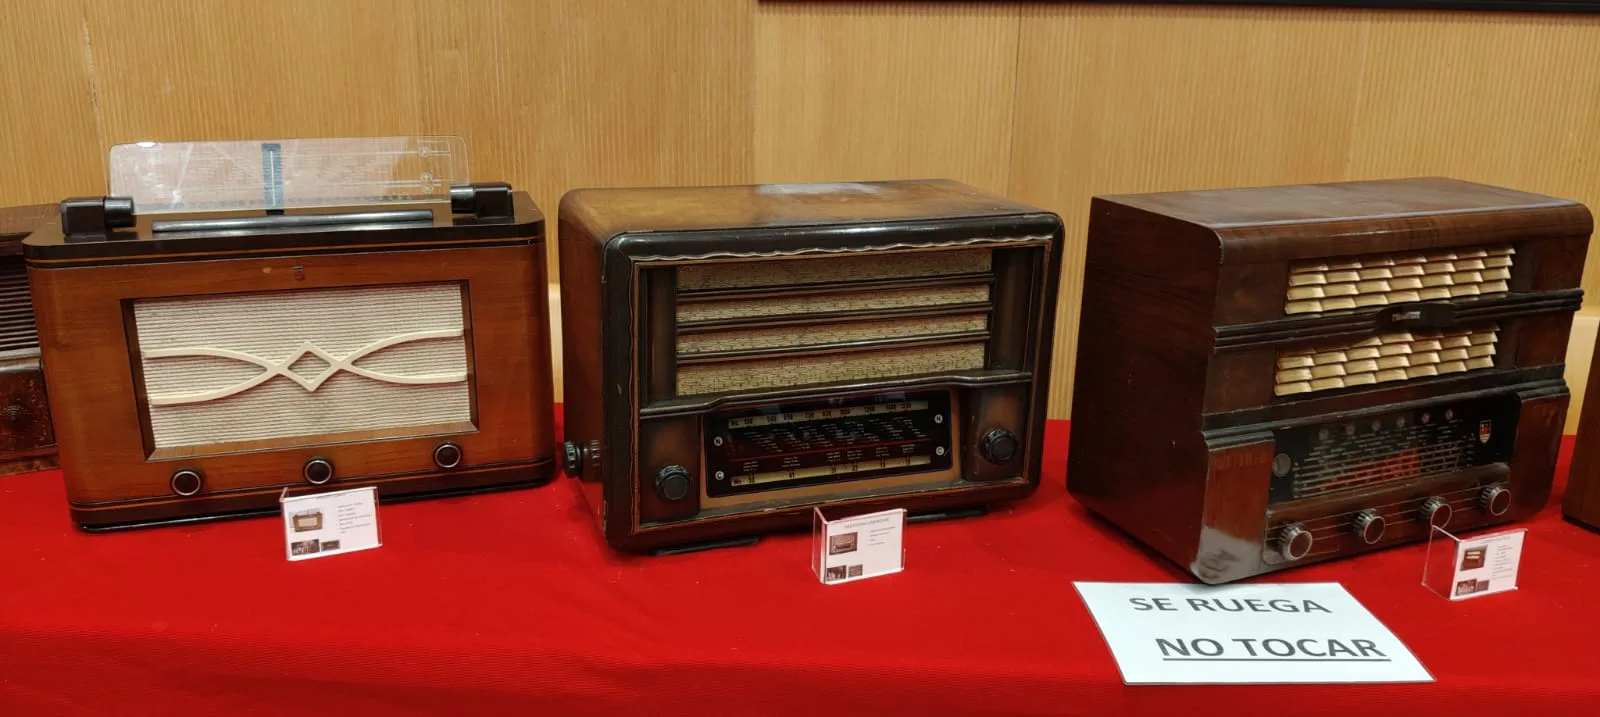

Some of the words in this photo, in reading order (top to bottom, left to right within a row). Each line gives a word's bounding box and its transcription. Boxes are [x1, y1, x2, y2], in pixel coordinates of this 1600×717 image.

[1129, 597, 1178, 611] SE
[1186, 597, 1332, 614] RUEGA
[1155, 638, 1225, 657] NO
[1231, 638, 1387, 658] TOCAR
